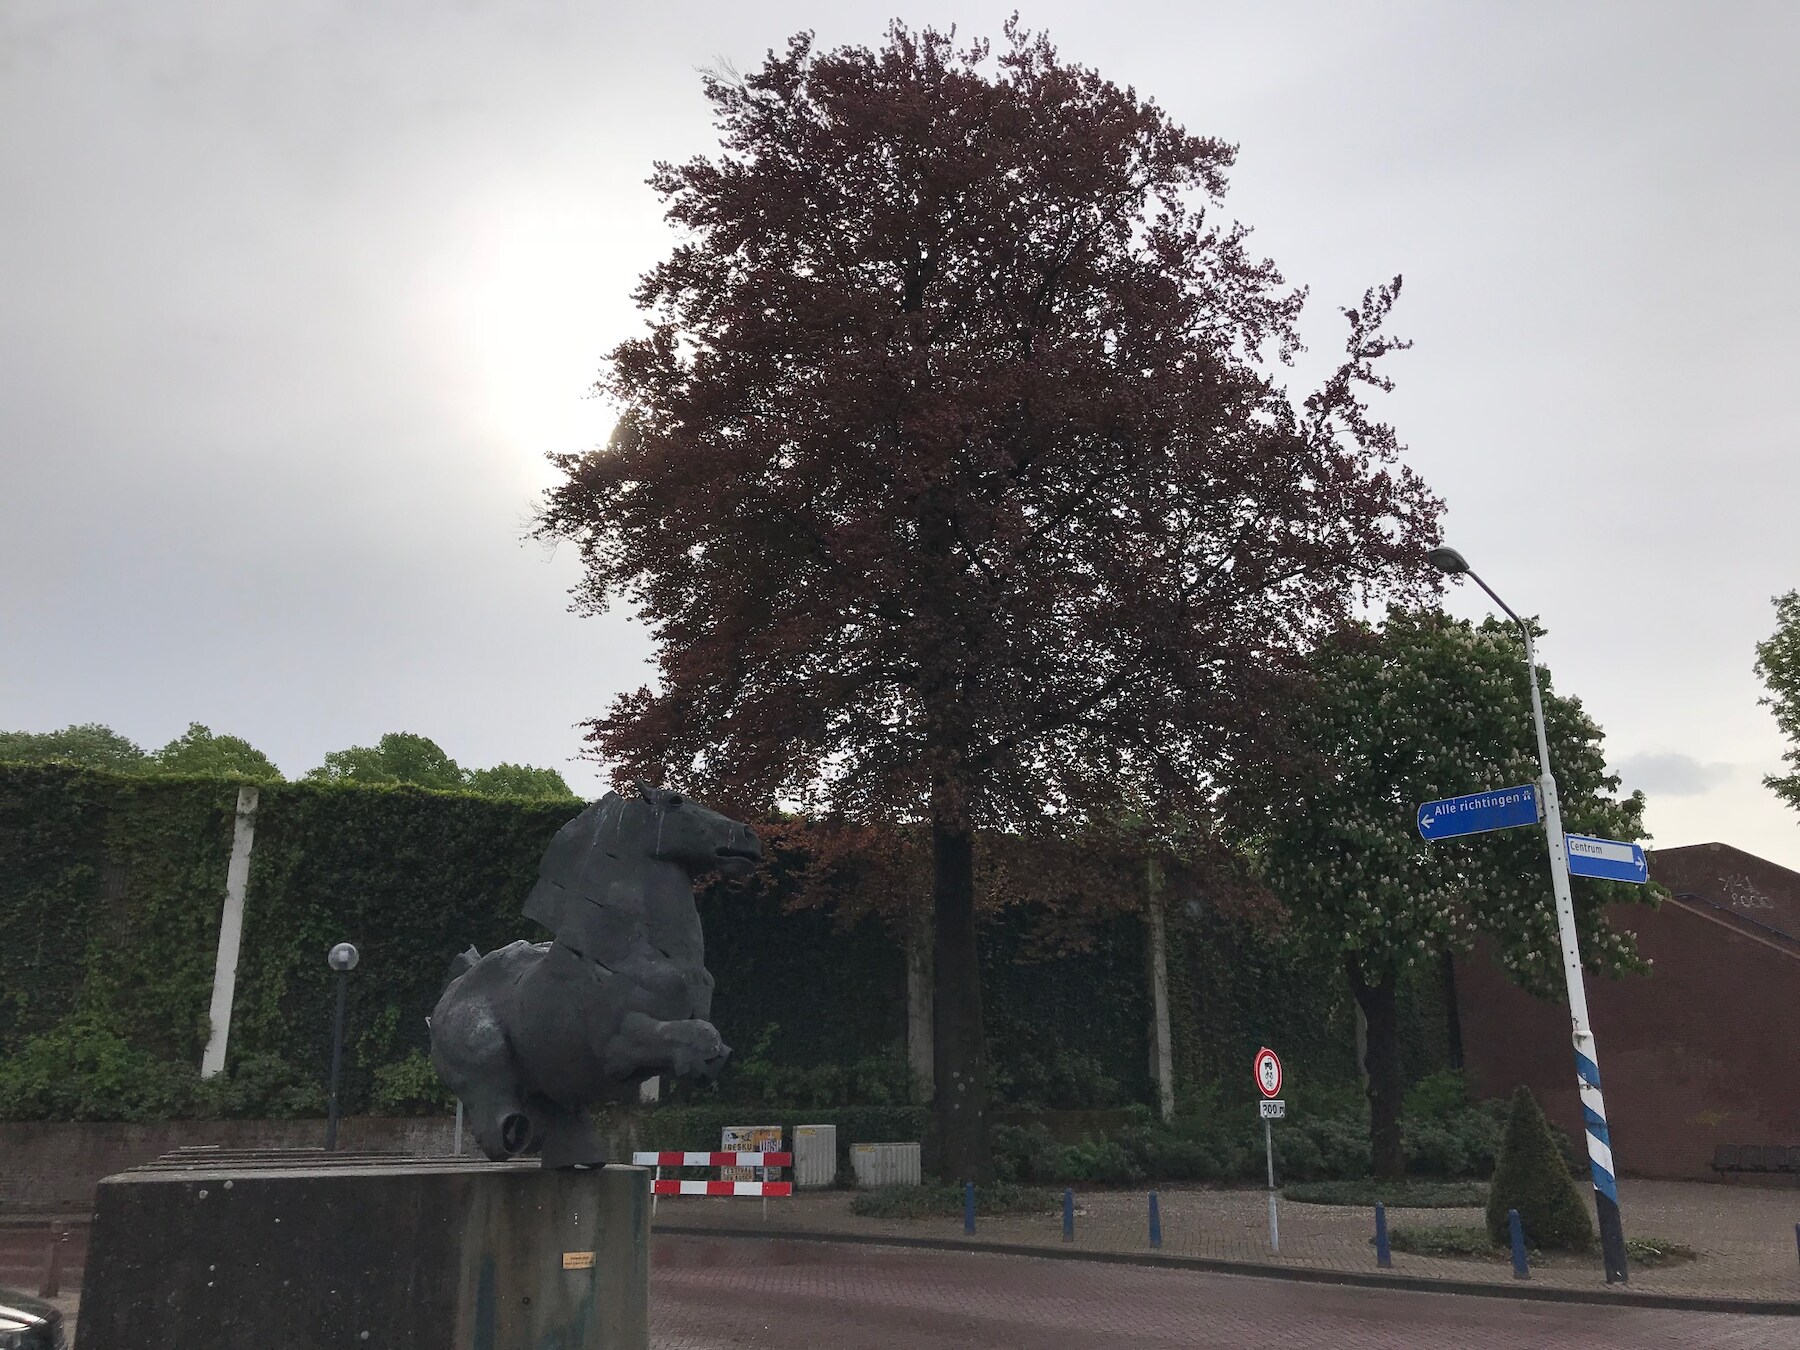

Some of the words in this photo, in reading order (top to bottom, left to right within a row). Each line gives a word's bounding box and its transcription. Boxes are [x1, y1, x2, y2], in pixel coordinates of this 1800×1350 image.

[1435, 803, 1457, 816] Alle
[1460, 792, 1520, 811] richtingen
[1570, 840, 1602, 854] Centrum
